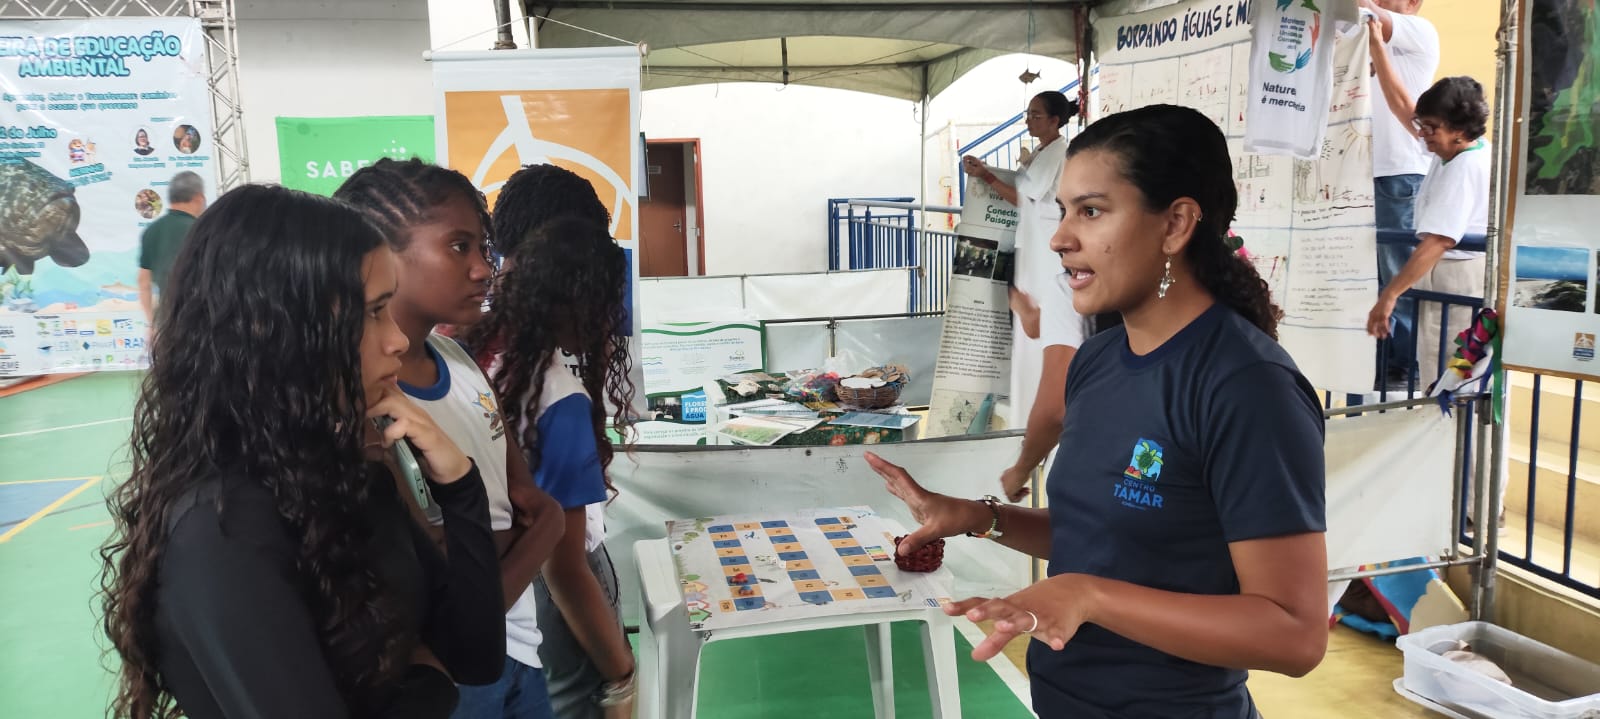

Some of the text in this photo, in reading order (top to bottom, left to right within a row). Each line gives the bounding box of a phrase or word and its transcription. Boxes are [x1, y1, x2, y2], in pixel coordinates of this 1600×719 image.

[1117, 0, 1251, 51] BORDANDO ÁGUAS E M
[44, 37, 71, 57] DE
[74, 31, 181, 62] EDUCAÇÃO
[19, 56, 131, 78] AMBIENTAL
[26, 126, 57, 138] Julho
[985, 213, 1018, 228] Paisage
[1113, 483, 1164, 509] TAMAR
[1123, 479, 1156, 492] CENTRO
